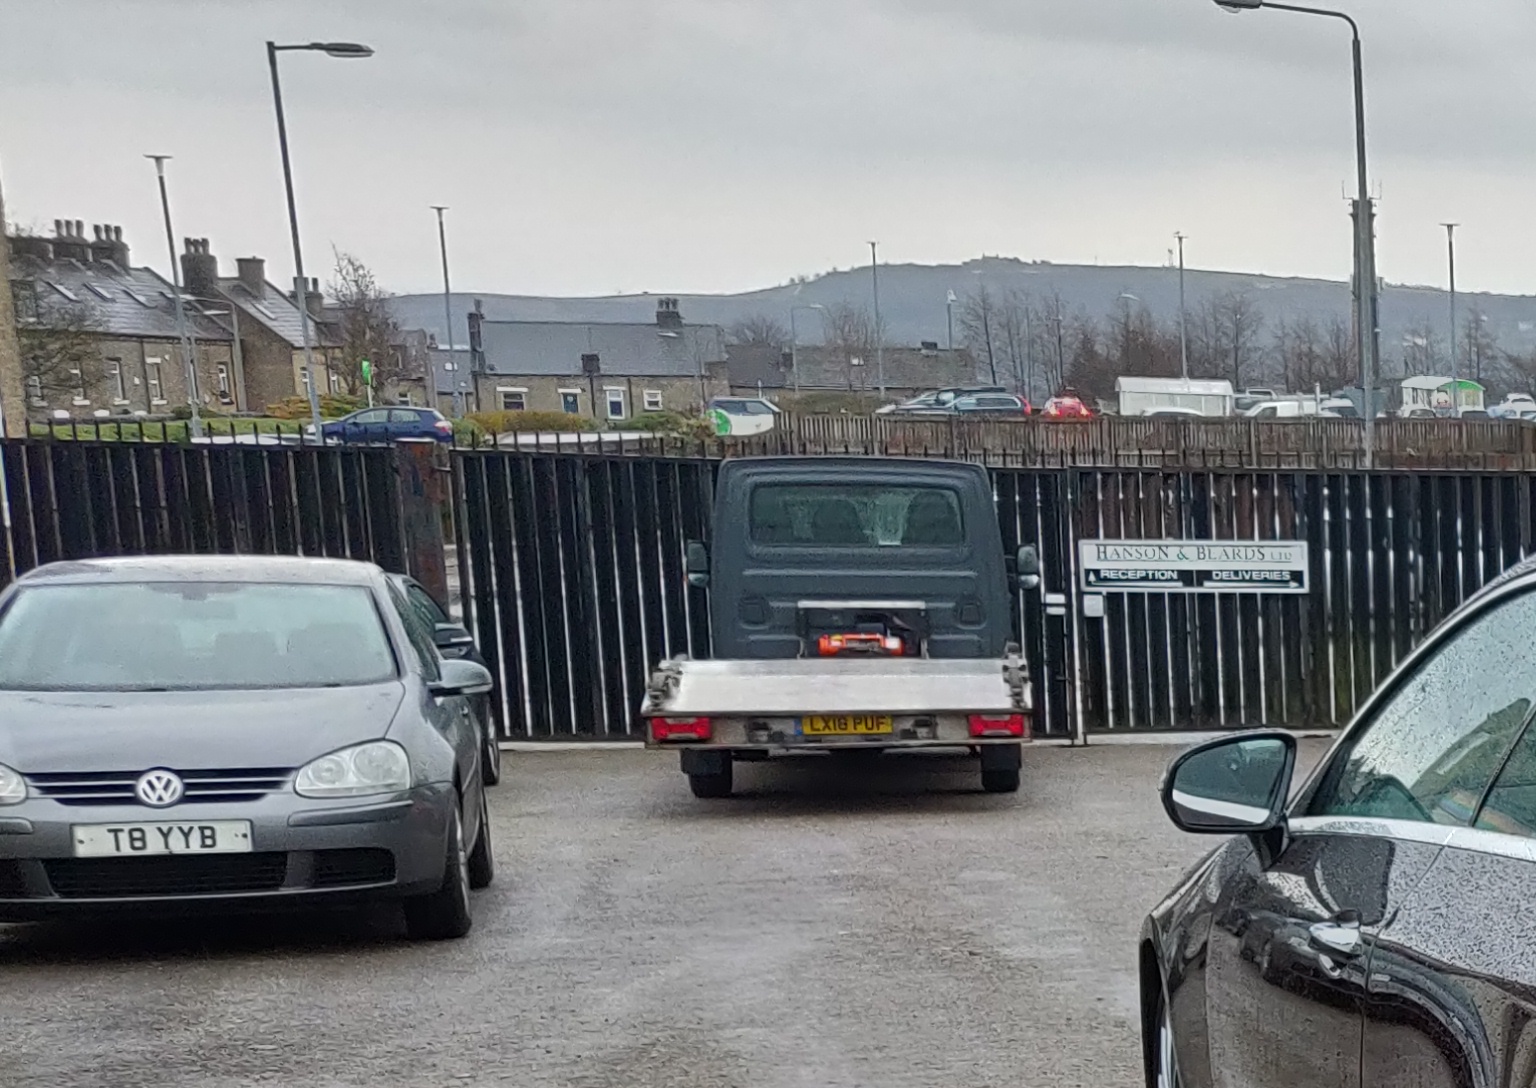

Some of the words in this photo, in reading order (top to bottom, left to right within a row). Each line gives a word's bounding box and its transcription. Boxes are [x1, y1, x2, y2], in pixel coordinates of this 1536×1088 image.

[1096, 544, 1169, 561] HANSON
[1176, 546, 1190, 561] &
[1197, 545, 1266, 561] BEARDS
[1100, 569, 1179, 580] RECEPTION
[1212, 570, 1292, 581] DELIVERIES
[853, 714, 887, 731] PUF
[156, 825, 217, 850] YYB
